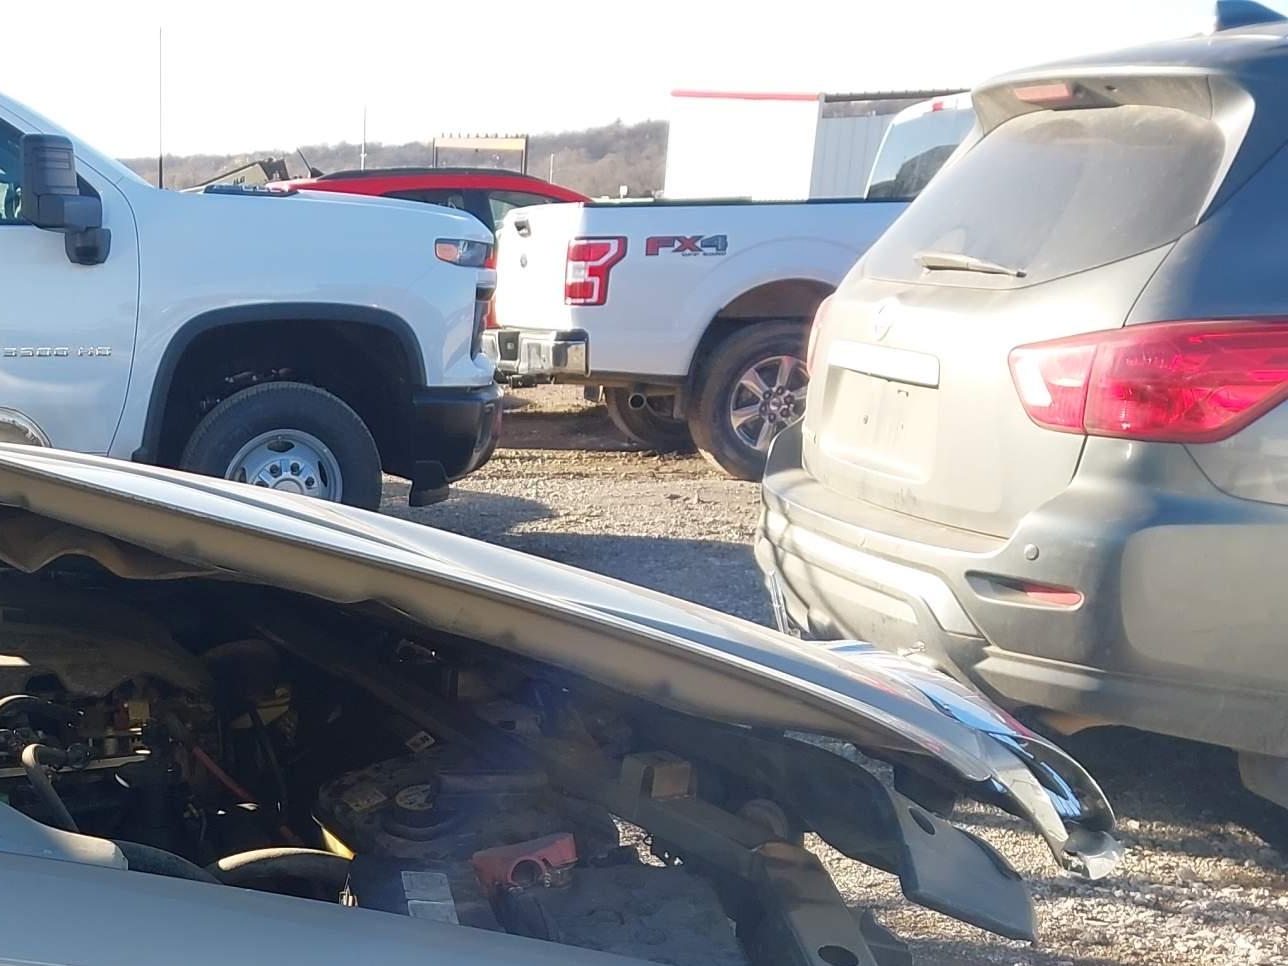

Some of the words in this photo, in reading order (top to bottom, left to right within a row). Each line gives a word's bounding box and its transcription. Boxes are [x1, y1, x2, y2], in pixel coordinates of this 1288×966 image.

[645, 235, 728, 256] FX4
[3, 346, 69, 357] 3500
[78, 345, 112, 357] HD
